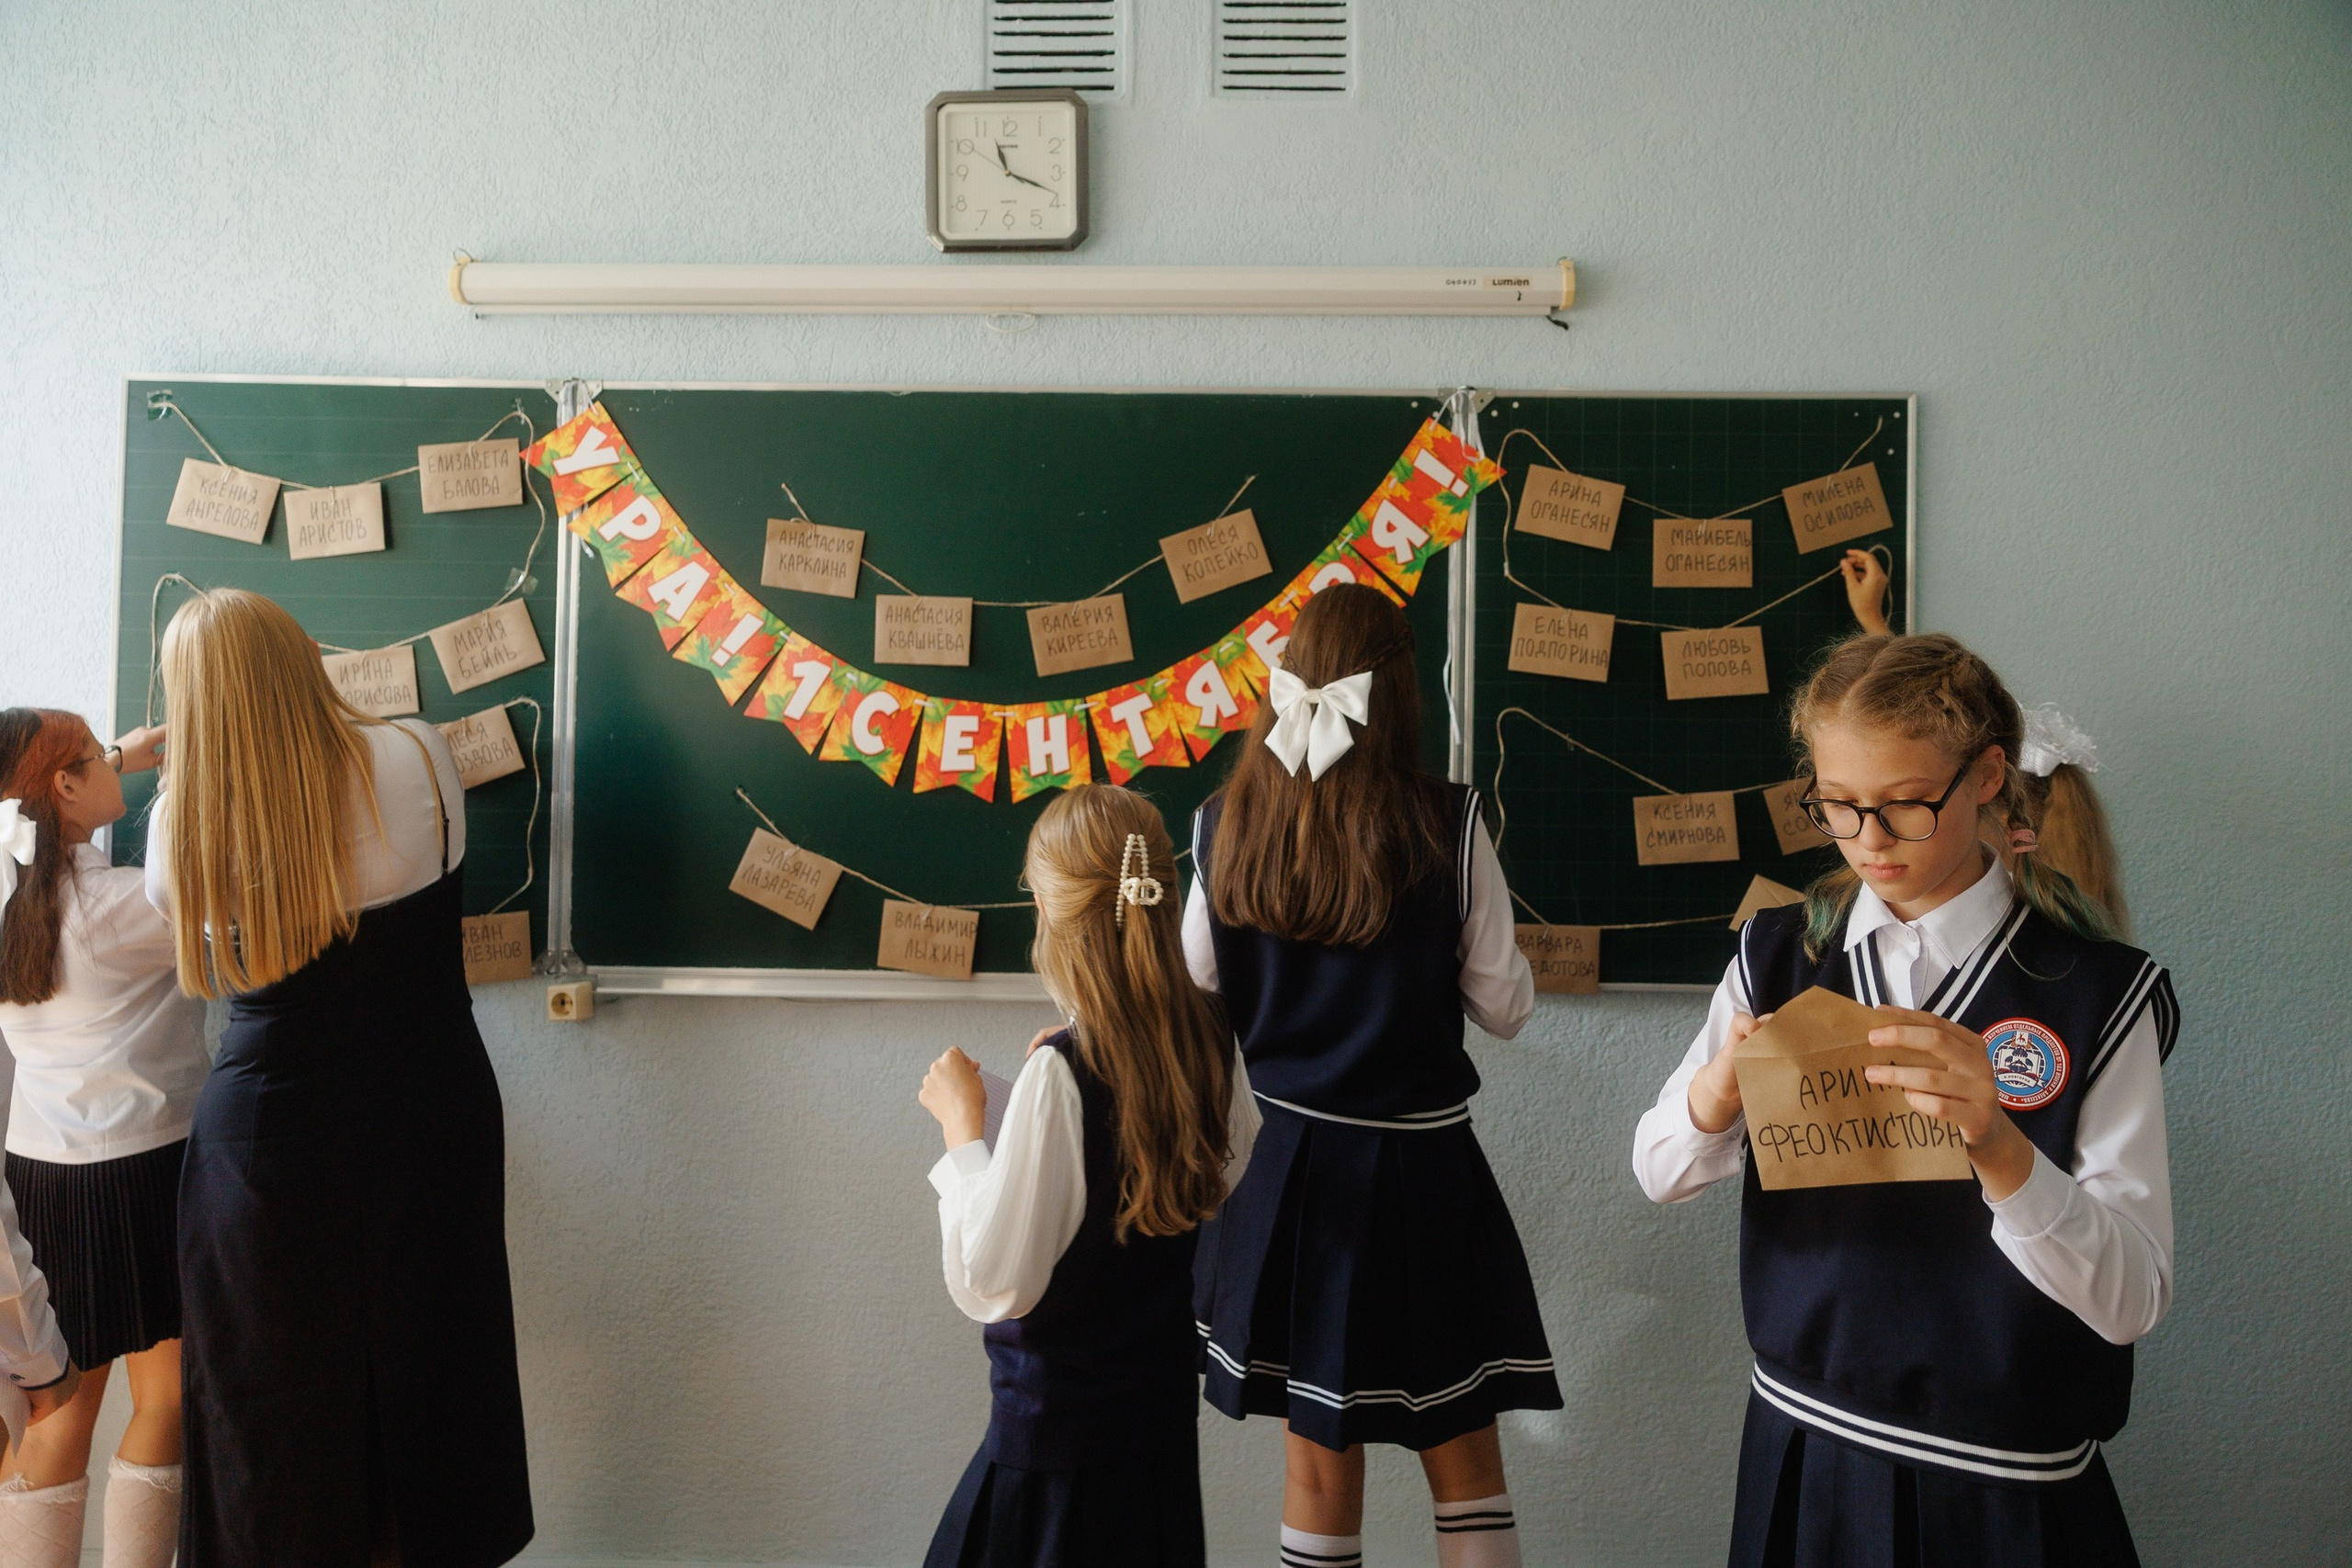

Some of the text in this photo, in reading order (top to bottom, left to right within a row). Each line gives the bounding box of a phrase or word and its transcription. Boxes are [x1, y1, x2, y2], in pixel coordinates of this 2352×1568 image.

[974, 120, 987, 137] 11
[1001, 119, 1018, 137] 12
[956, 139, 974, 154] 10
[1048, 137, 1062, 154] 2
[956, 164, 969, 182] 9
[1050, 164, 1062, 182] 3
[955, 195, 967, 212] 8
[1049, 192, 1060, 209] 4
[976, 209, 988, 226] 7
[1001, 210, 1015, 228] 6
[1030, 209, 1043, 227] 5
[428, 449, 509, 474] ЕЛИЗАВЕТА
[199, 478, 258, 505] КСЕНИЯ
[1549, 479, 1602, 507] АРИНА
[310, 498, 352, 520] ИВАН
[1531, 499, 1611, 533] ОГАНЕСЯН
[299, 517, 367, 547] АРИСТОВ
[779, 529, 854, 555] АНАСТАСИЯ
[1187, 525, 1239, 556] ОЛЕСЯ
[553, 425, 764, 667] УРА!
[784, 660, 831, 721] 1
[778, 554, 847, 579] КАРКЛИНА
[1182, 541, 1259, 583] КОПЕЙКО
[1665, 554, 1750, 573] ОГАНЕСЯН
[885, 604, 964, 626] АНАСТАСИЯ
[1042, 605, 1114, 633] ВАЛЕРИЯ
[454, 618, 508, 653] МАРИЯ
[1534, 616, 1589, 640] ЕЛЕНА
[1046, 628, 1118, 657] КИРЕЕВА
[1516, 637, 1608, 669] ПОДПОРИНА
[1681, 638, 1751, 659] ЛЮБОВЬ
[338, 658, 393, 684] ИРИНА
[1683, 660, 1752, 680] ПОПОВА
[344, 684, 413, 705] ОРИСОВА
[447, 721, 489, 750] ЛЕСЯ
[1654, 802, 1716, 821] КСЕНИЯ
[1645, 827, 1726, 849] СМИРНОВА
[763, 844, 821, 887] УЛЬЯНА
[742, 863, 816, 913] ЛАЗАРЕВА
[465, 941, 522, 964] ЛЕЗНОВ
[1799, 1060, 1905, 1110] АРИ
